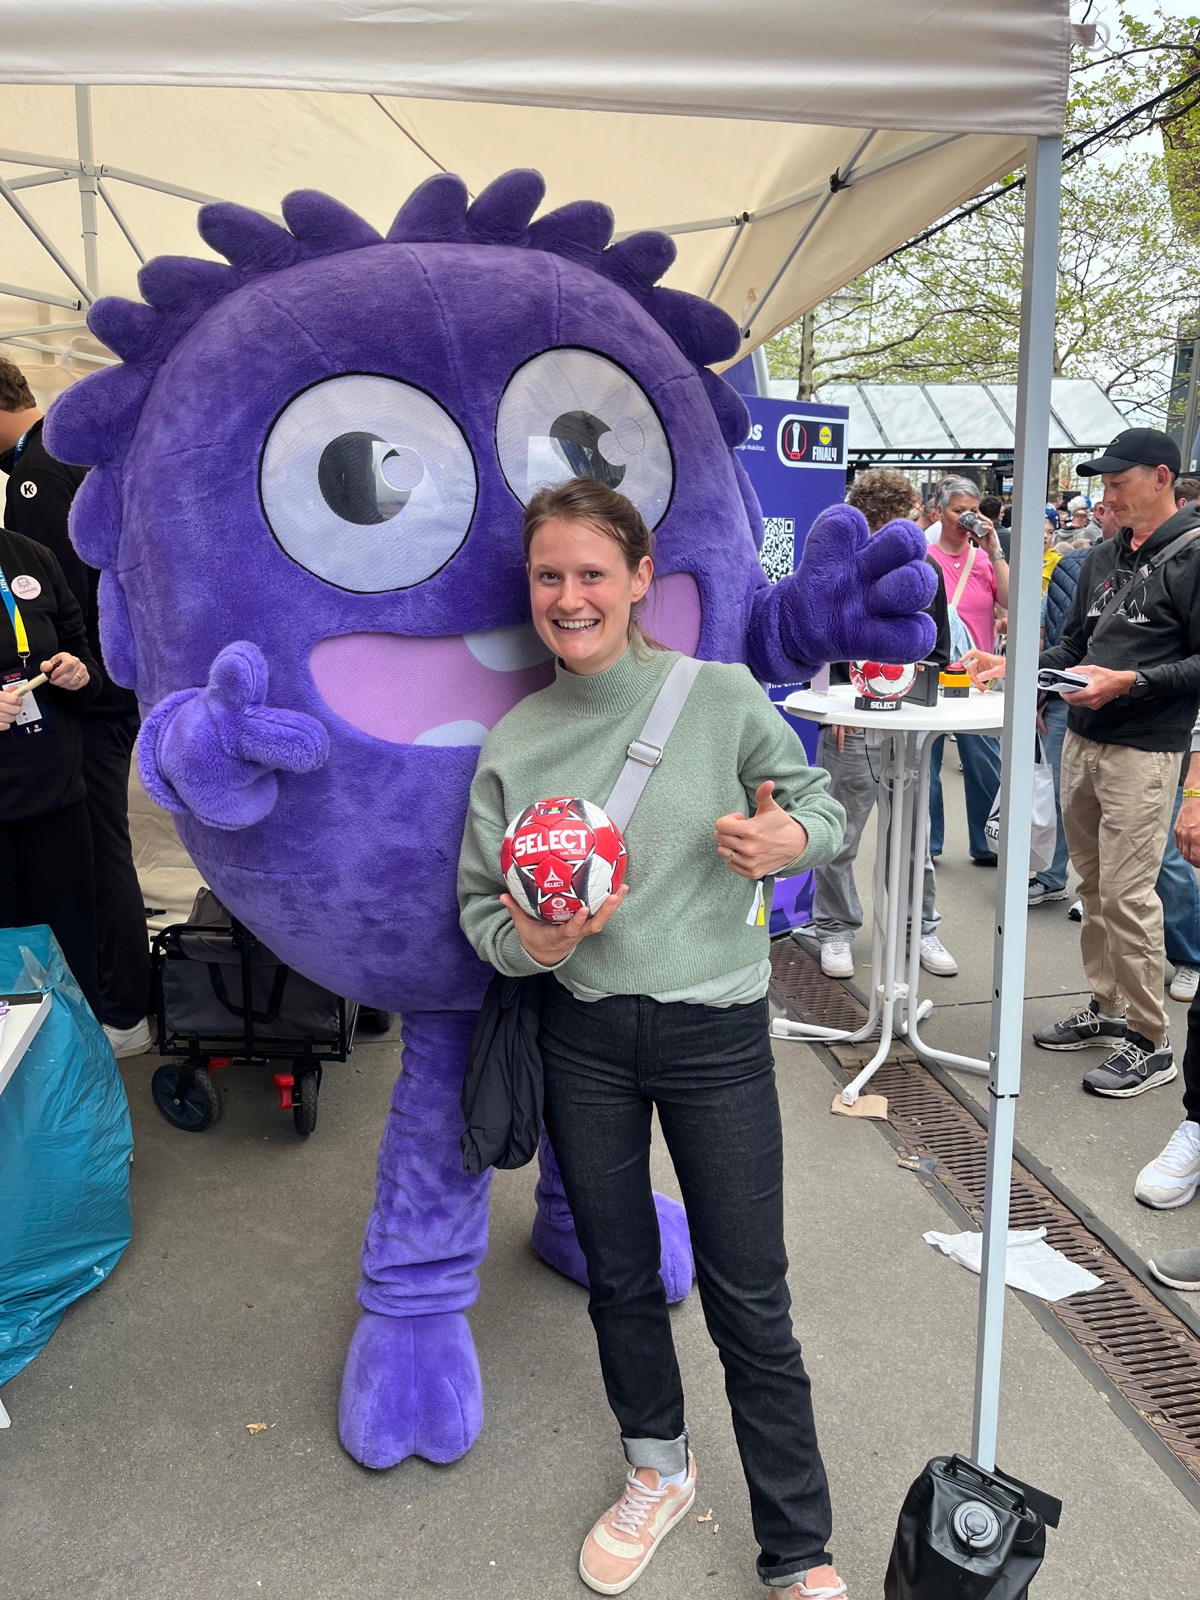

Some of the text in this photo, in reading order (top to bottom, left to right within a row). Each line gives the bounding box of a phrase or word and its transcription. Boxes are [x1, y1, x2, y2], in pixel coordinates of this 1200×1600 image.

[812, 446, 837, 462] FINAL4
[870, 701, 897, 710] SELECT
[515, 829, 587, 857] SELECT
